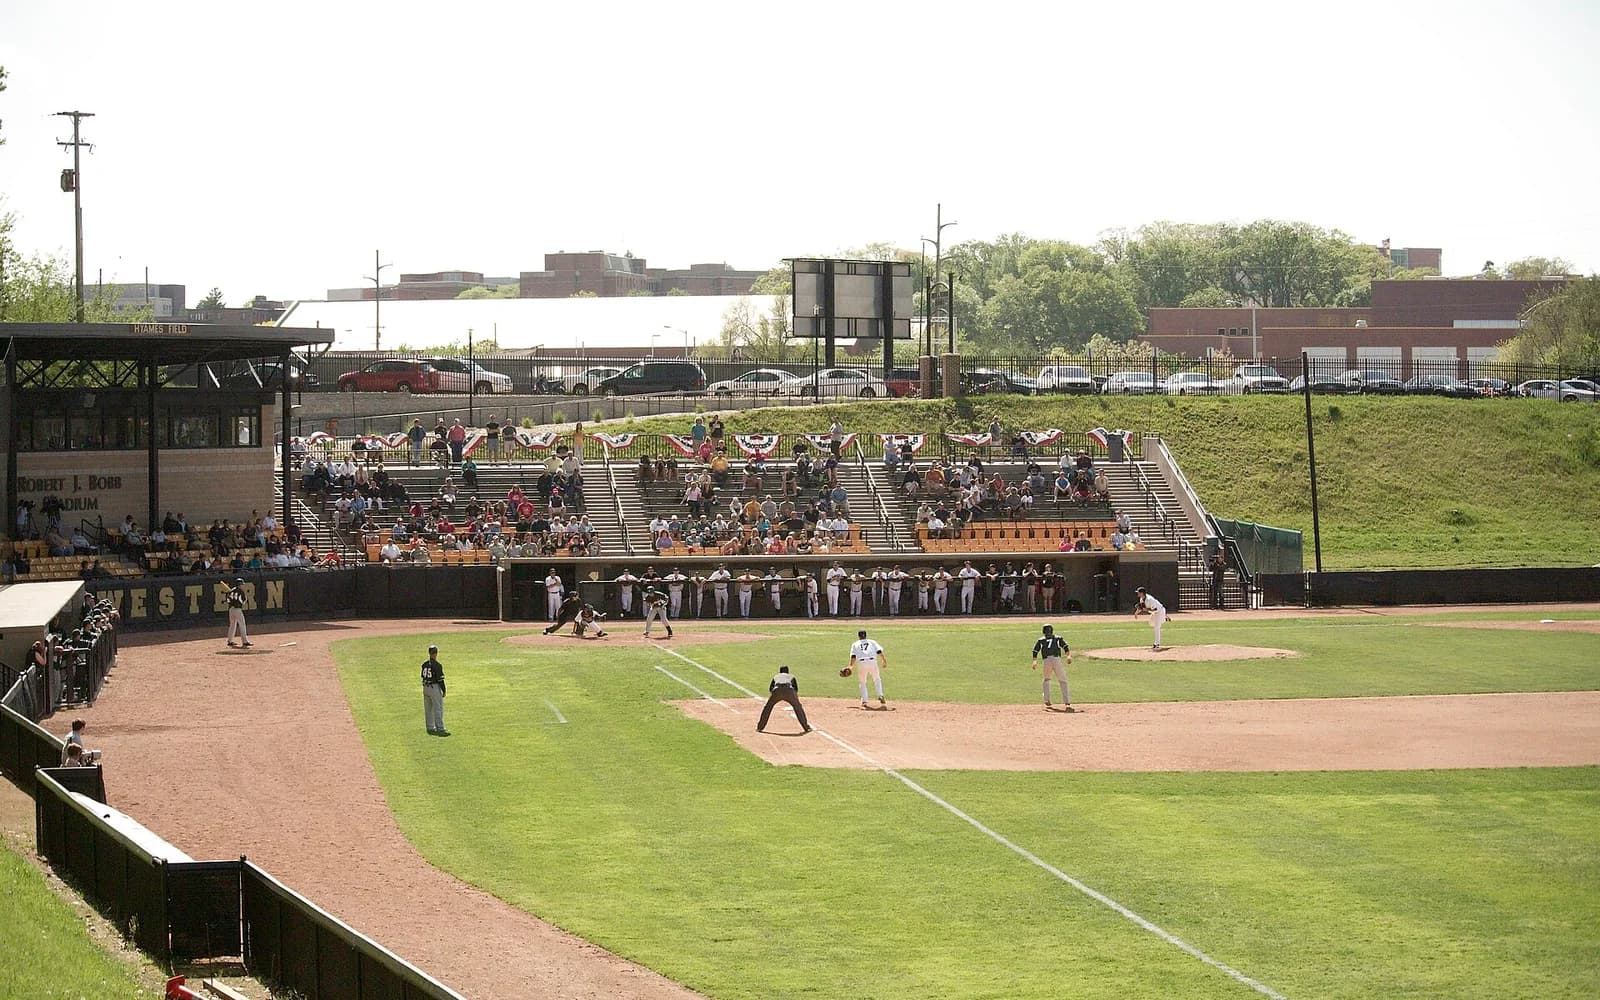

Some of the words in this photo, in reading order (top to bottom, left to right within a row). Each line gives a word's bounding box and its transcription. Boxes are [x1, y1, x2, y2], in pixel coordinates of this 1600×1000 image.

[168, 325, 187, 334] FIELD
[72, 475, 82, 493] J.
[88, 475, 122, 490] BOBB
[860, 642, 869, 651] 17
[1046, 639, 1053, 649] 7
